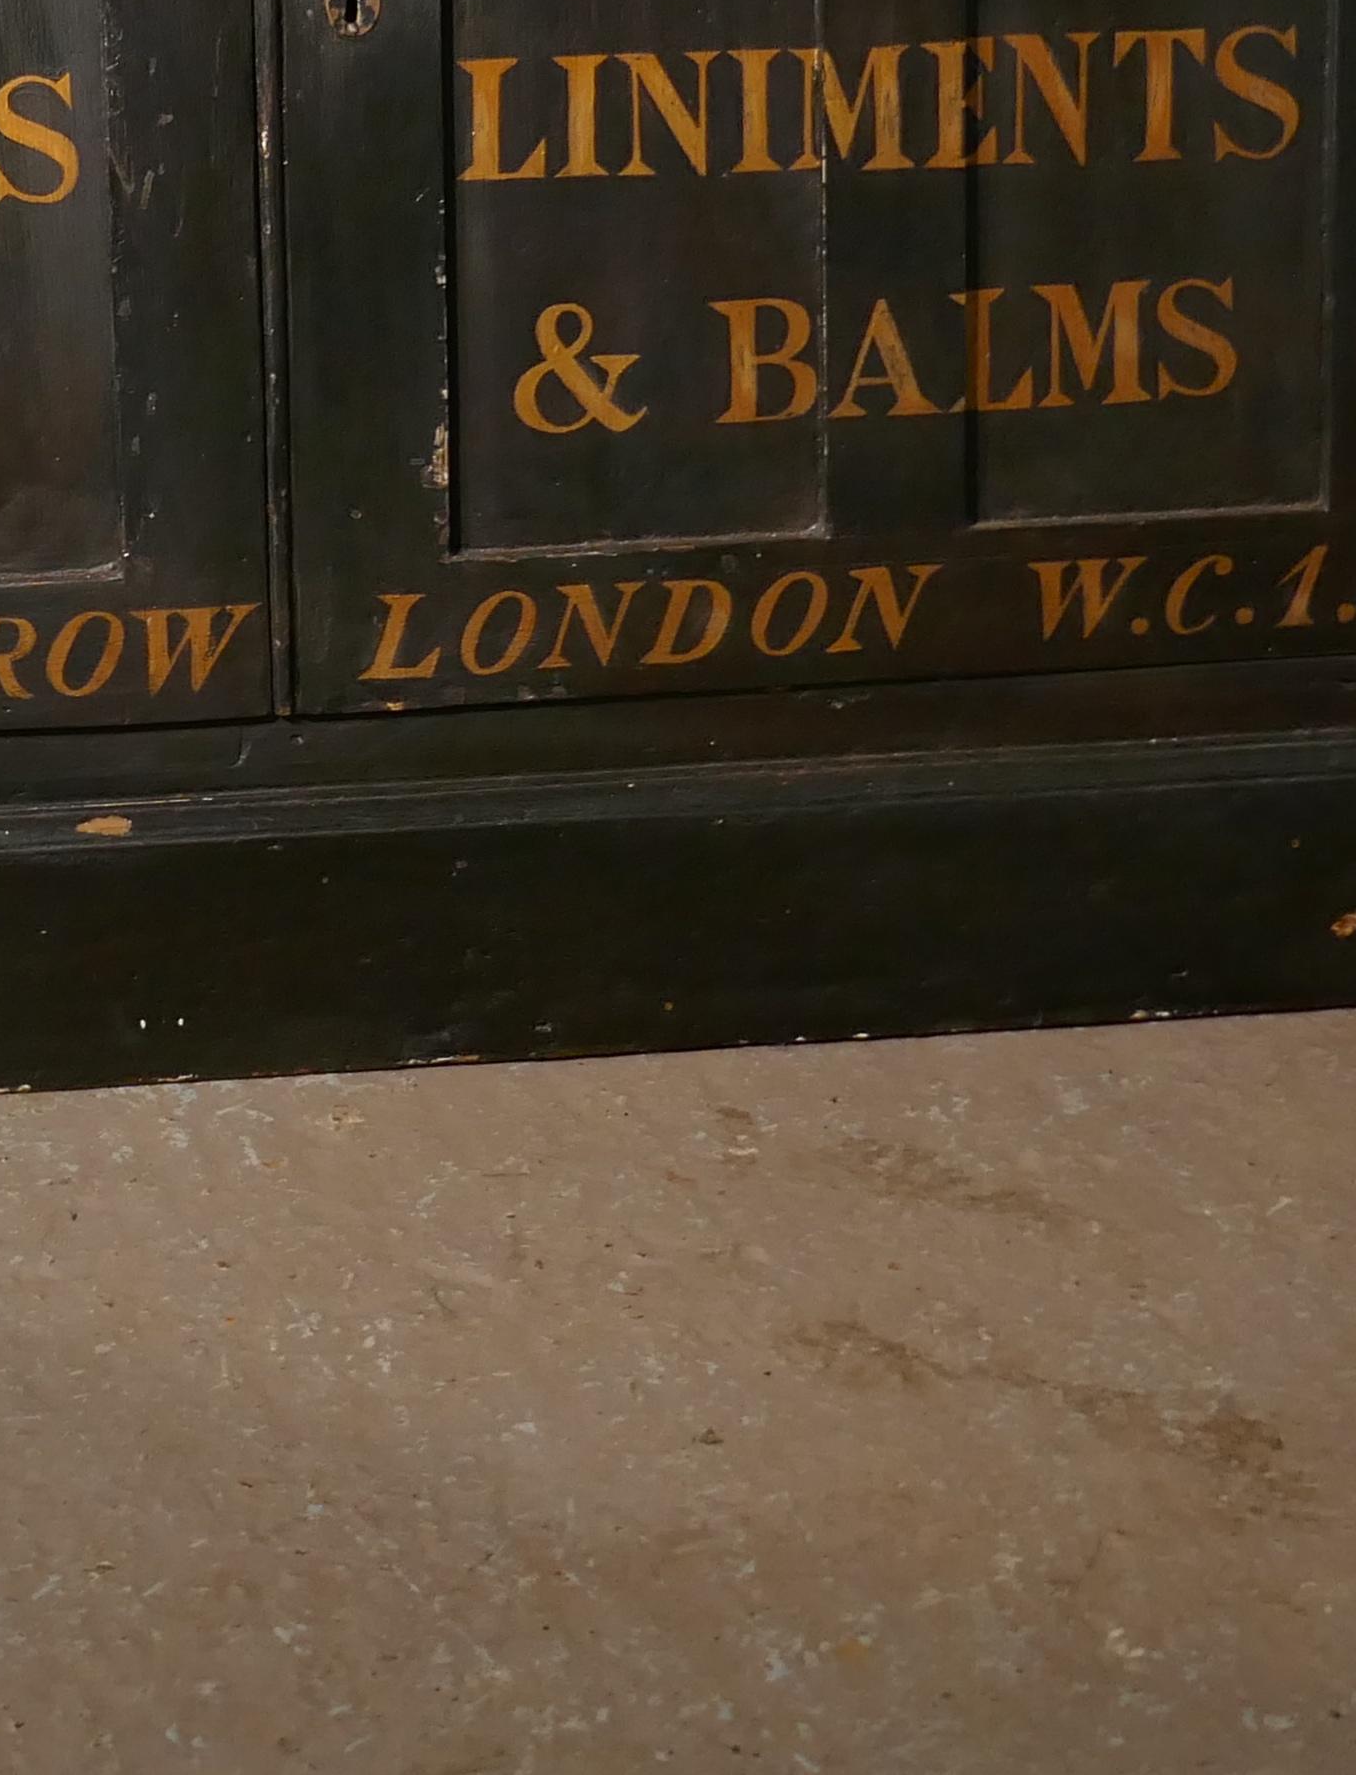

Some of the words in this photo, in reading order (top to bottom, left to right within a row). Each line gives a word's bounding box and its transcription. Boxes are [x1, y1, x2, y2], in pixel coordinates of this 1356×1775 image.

[456, 25, 1301, 181] LINIMENTS
[512, 302, 648, 434] &
[707, 275, 1239, 423] BALMS
[359, 564, 946, 681] LONDON
